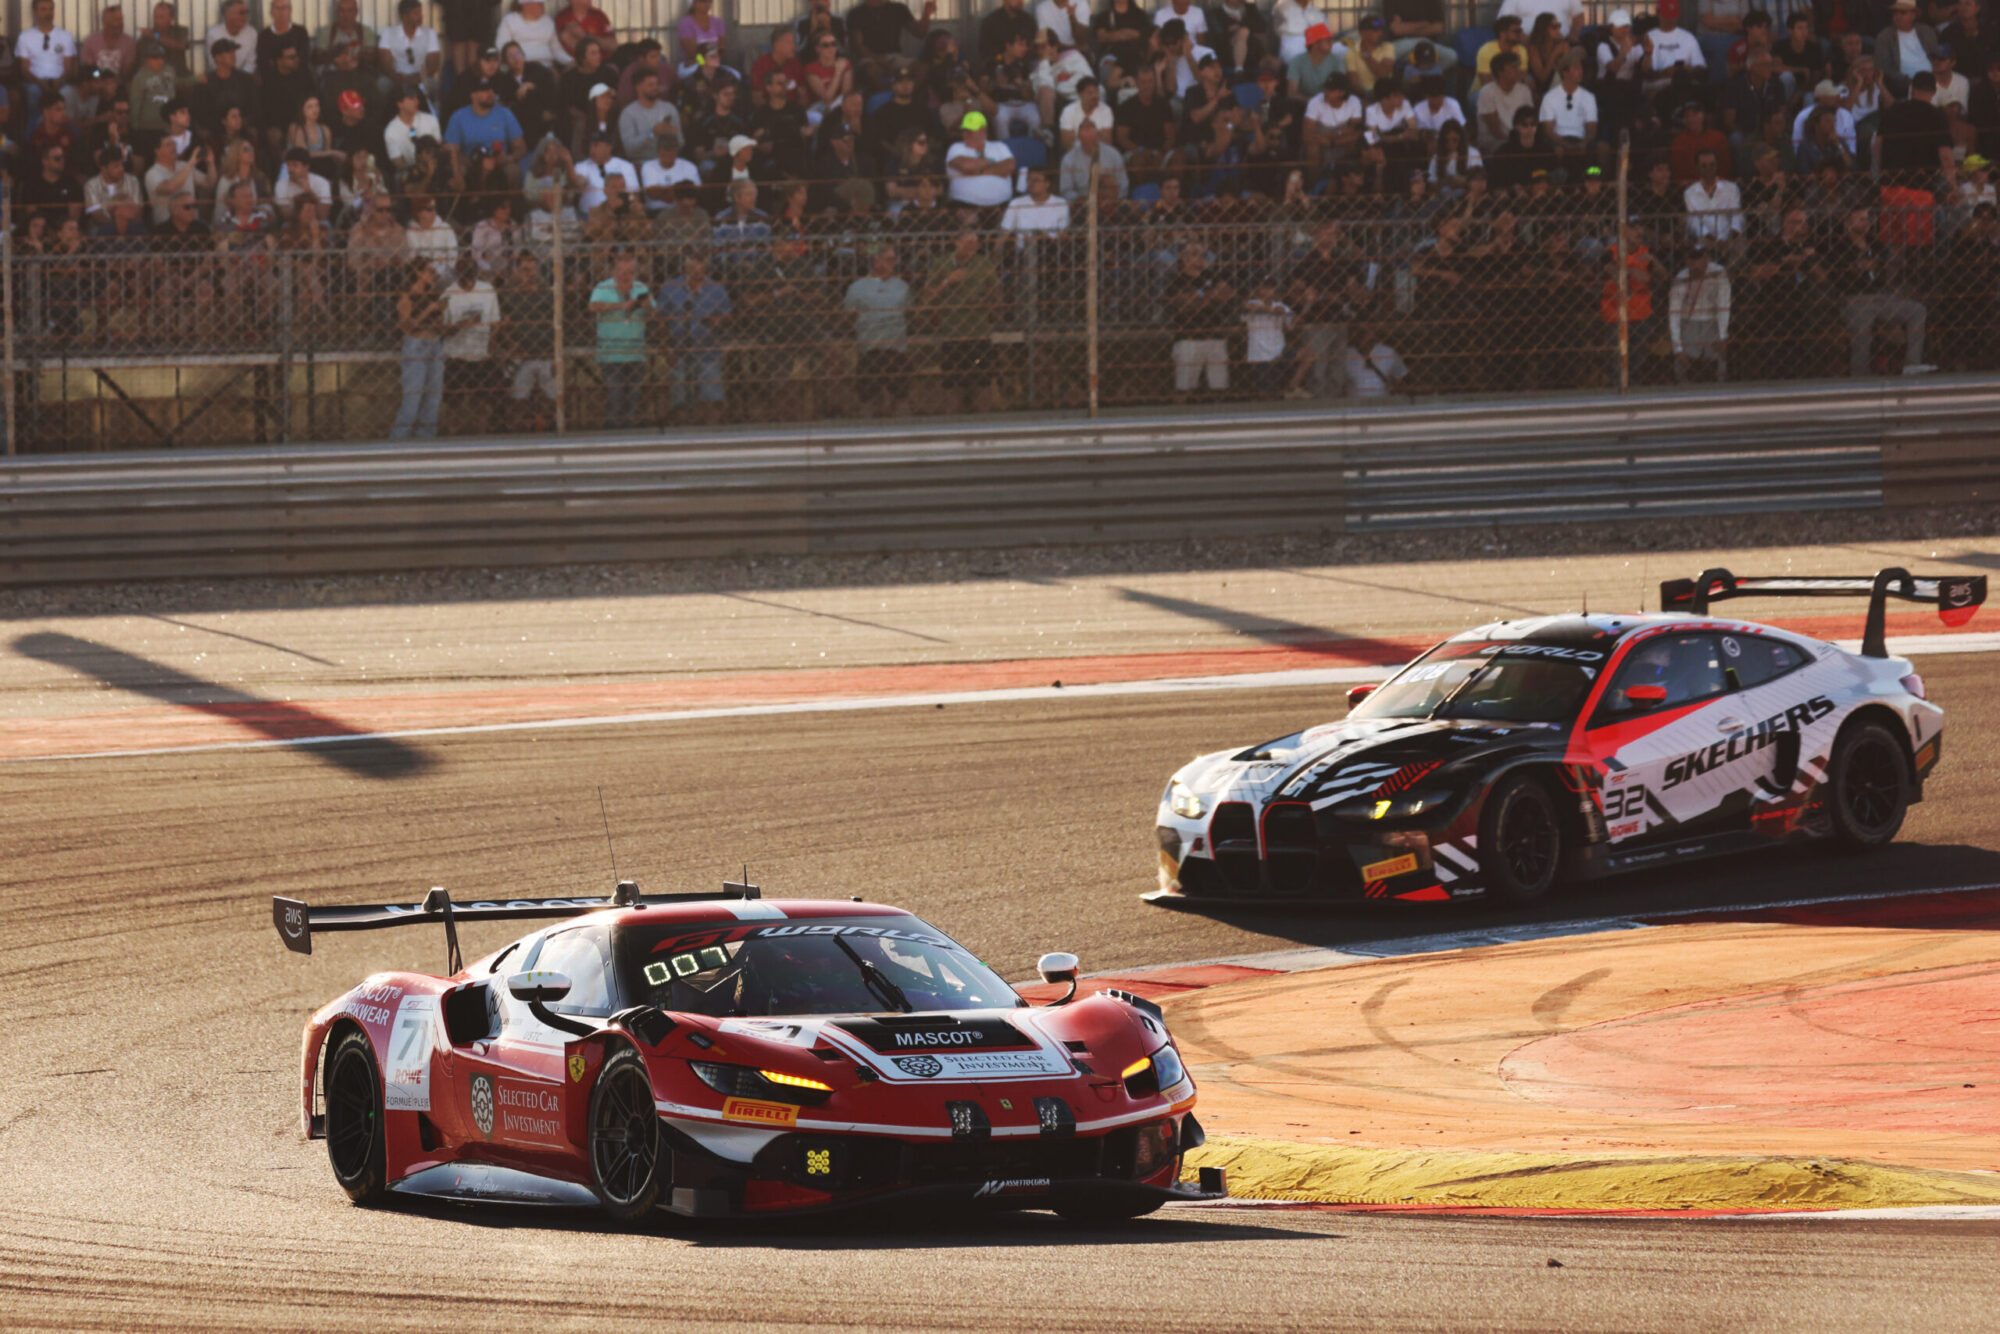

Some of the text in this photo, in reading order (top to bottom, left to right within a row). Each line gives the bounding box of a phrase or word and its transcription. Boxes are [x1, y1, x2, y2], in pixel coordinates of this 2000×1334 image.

[1480, 645, 1604, 661] WORLD
[1661, 694, 1836, 791] SKECHERS
[1605, 784, 1645, 819] 32
[1366, 857, 1412, 878] PIRELLI
[284, 906, 302, 926] aws
[651, 923, 952, 954] GT WORLD
[943, 1054, 1046, 1063] SELECTED CAR
[498, 1085, 560, 1112] SELECTED CAR
[728, 1101, 792, 1121] PIRELLI
